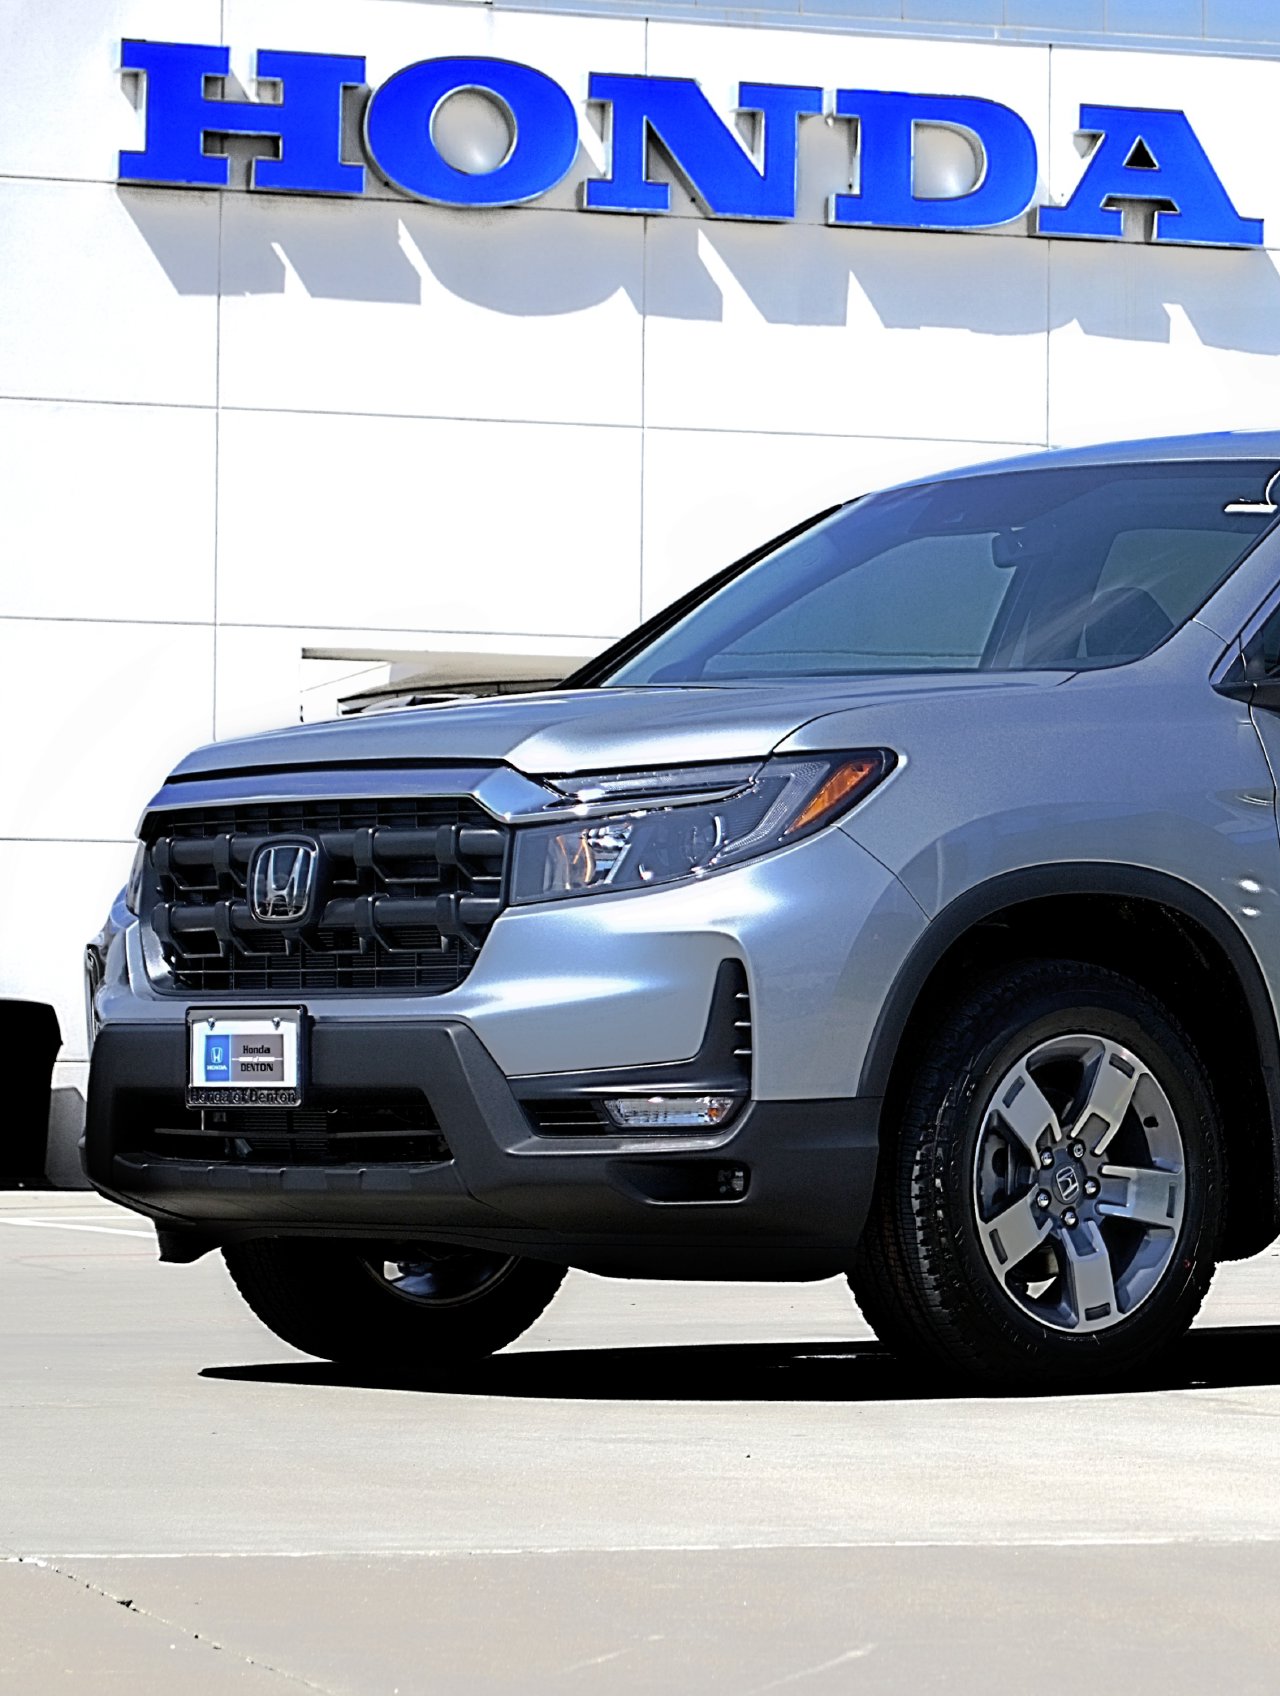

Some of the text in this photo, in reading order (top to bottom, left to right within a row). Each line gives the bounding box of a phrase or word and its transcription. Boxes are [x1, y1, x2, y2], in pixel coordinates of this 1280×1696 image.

[118, 39, 1264, 247] HONDA
[243, 1045, 270, 1054] Honda
[240, 1063, 273, 1072] DENTON
[249, 1088, 296, 1104] Denton
